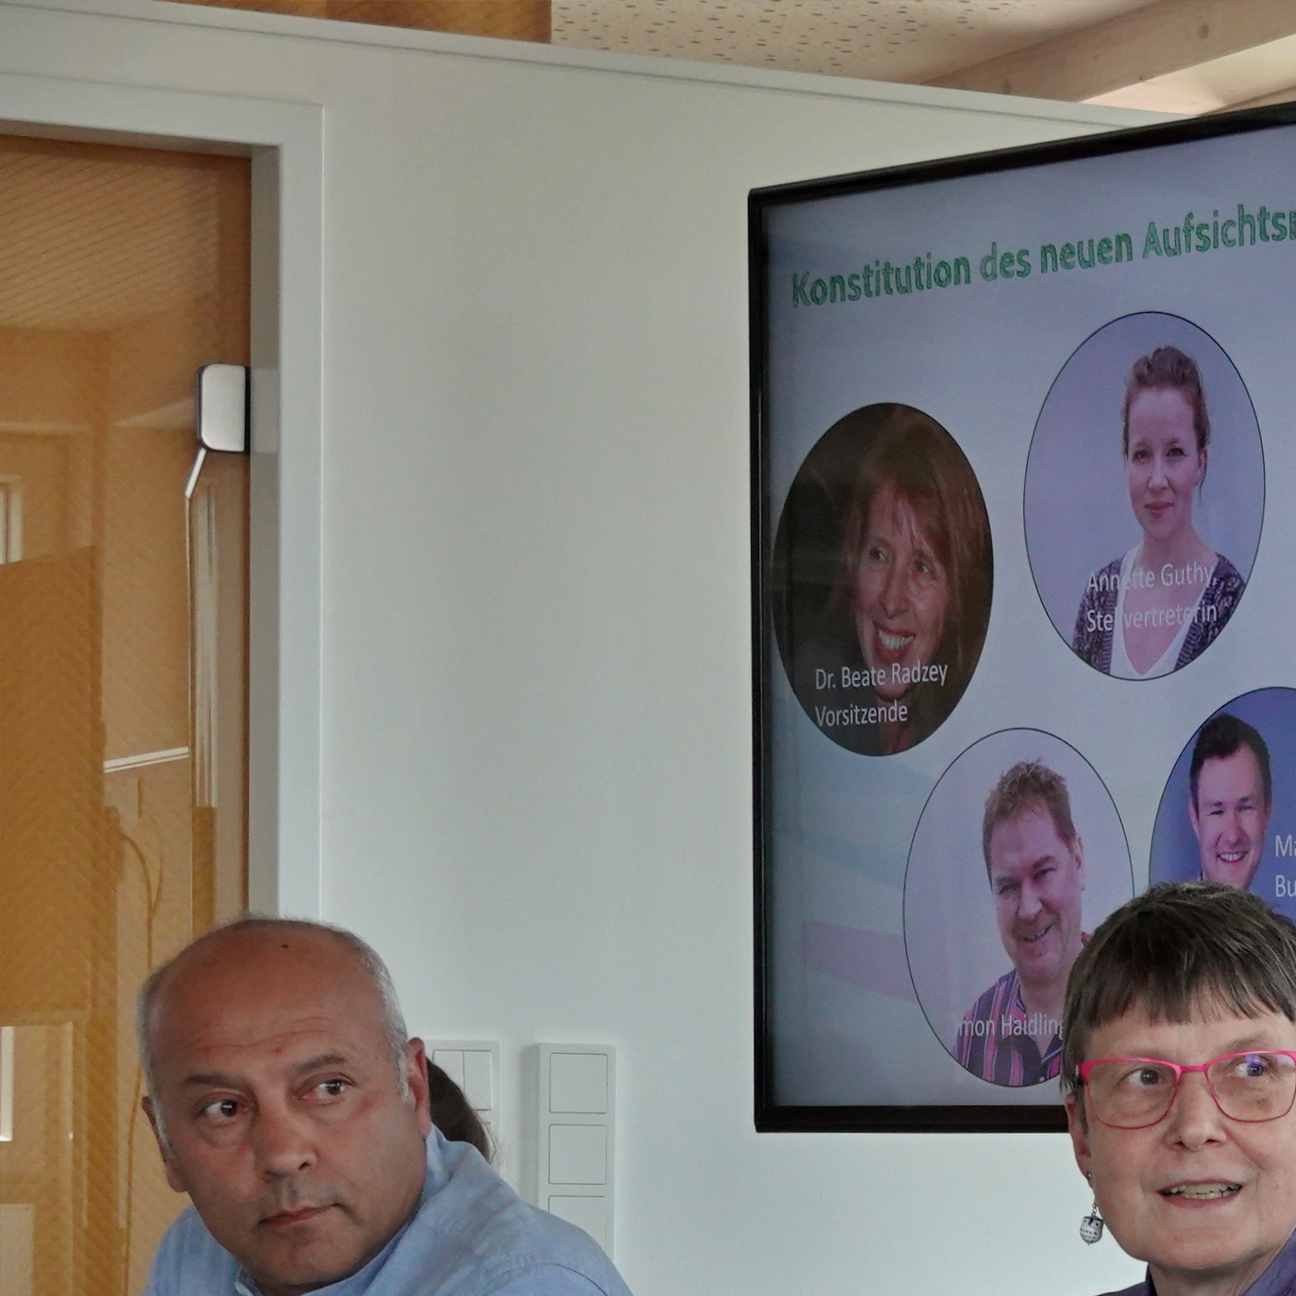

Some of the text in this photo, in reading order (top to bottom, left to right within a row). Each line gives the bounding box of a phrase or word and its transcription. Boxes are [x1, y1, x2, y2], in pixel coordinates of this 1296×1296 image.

[791, 252, 971, 308] Konstitution
[979, 241, 1032, 282] des
[1040, 232, 1134, 274] neuen
[1087, 601, 1218, 633] Stevertreterin
[815, 658, 948, 690] Dr. Beate Radzey
[814, 699, 908, 727] Vorsitzende
